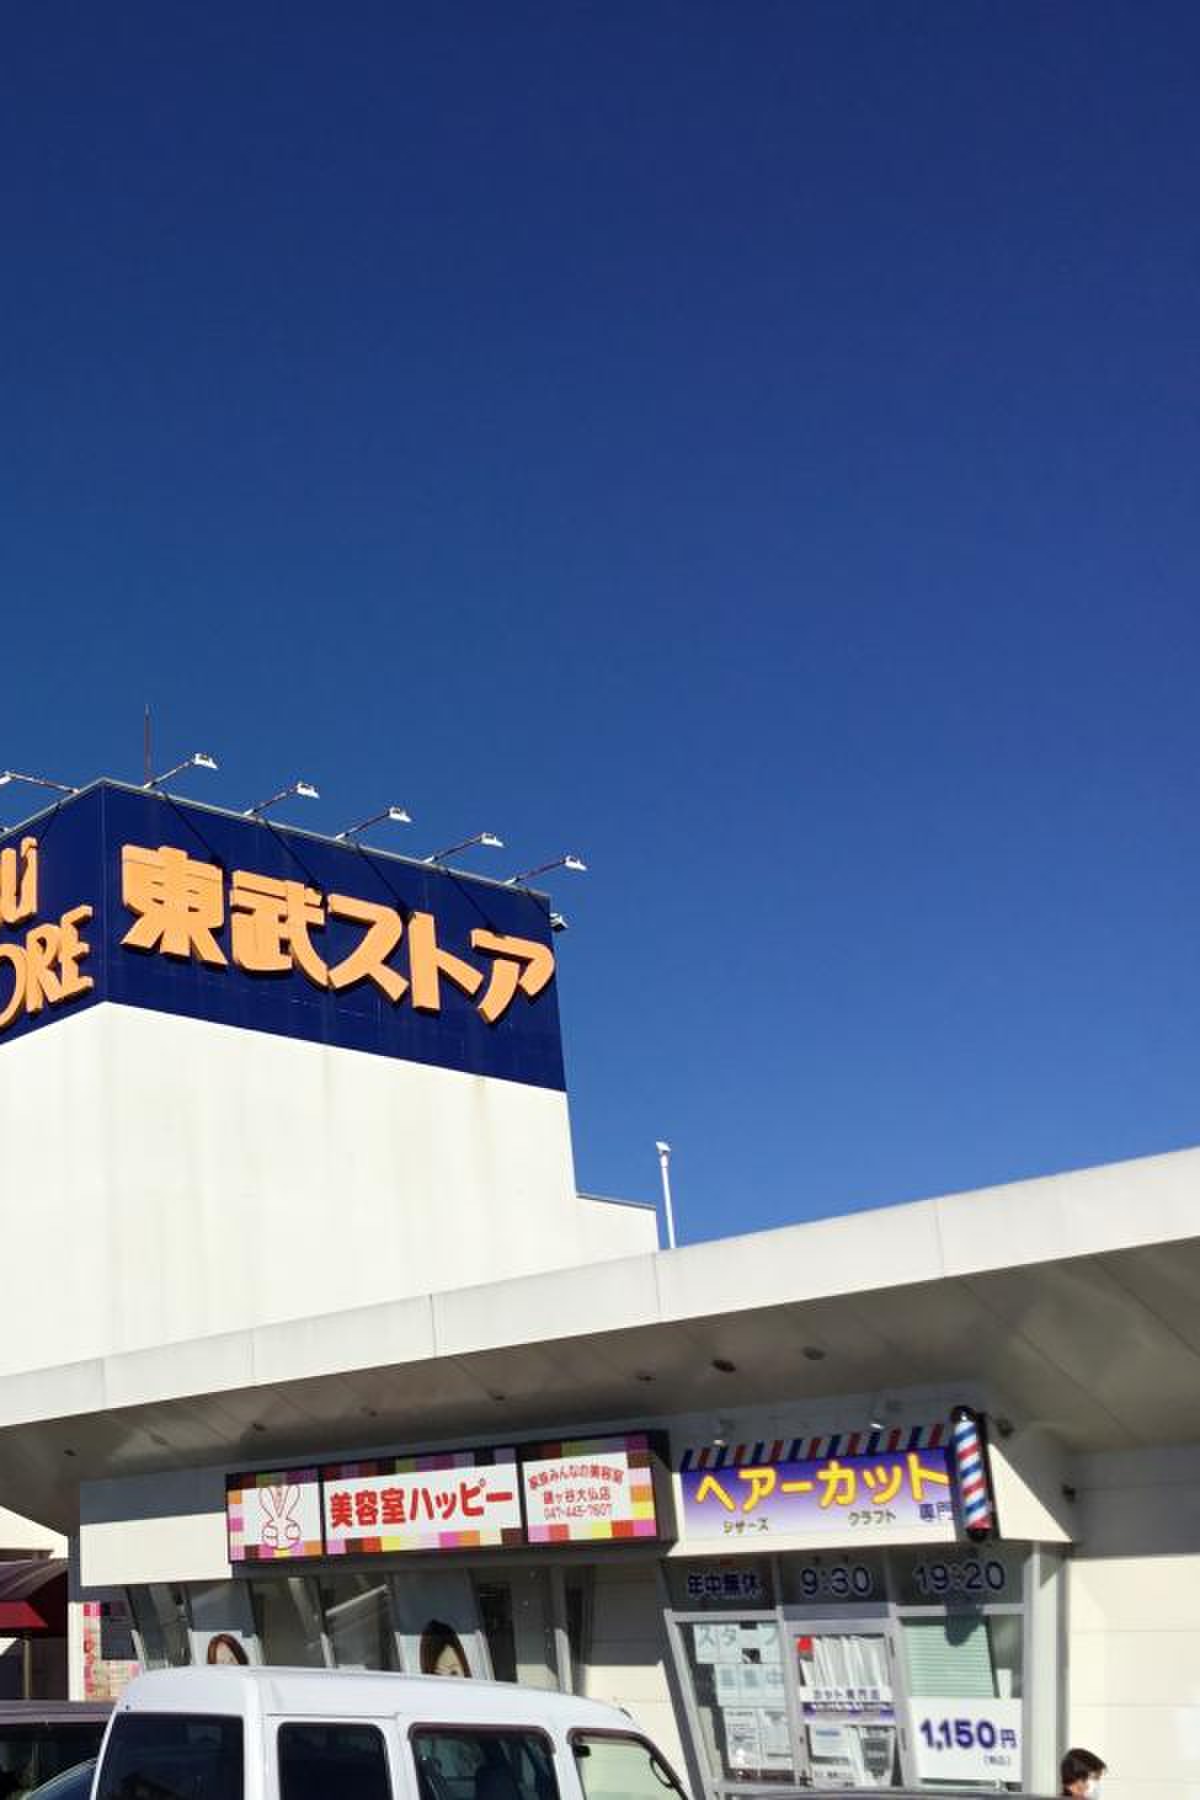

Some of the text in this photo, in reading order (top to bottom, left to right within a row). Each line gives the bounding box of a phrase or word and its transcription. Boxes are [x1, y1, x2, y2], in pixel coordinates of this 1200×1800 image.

[120, 844, 556, 1023] 東武ストア
[330, 1478, 513, 1528] 美容室ハッピー
[695, 1453, 949, 1514] ヘアーカット
[801, 1566, 871, 1595] 9:30
[915, 1561, 1005, 1592] 19:20
